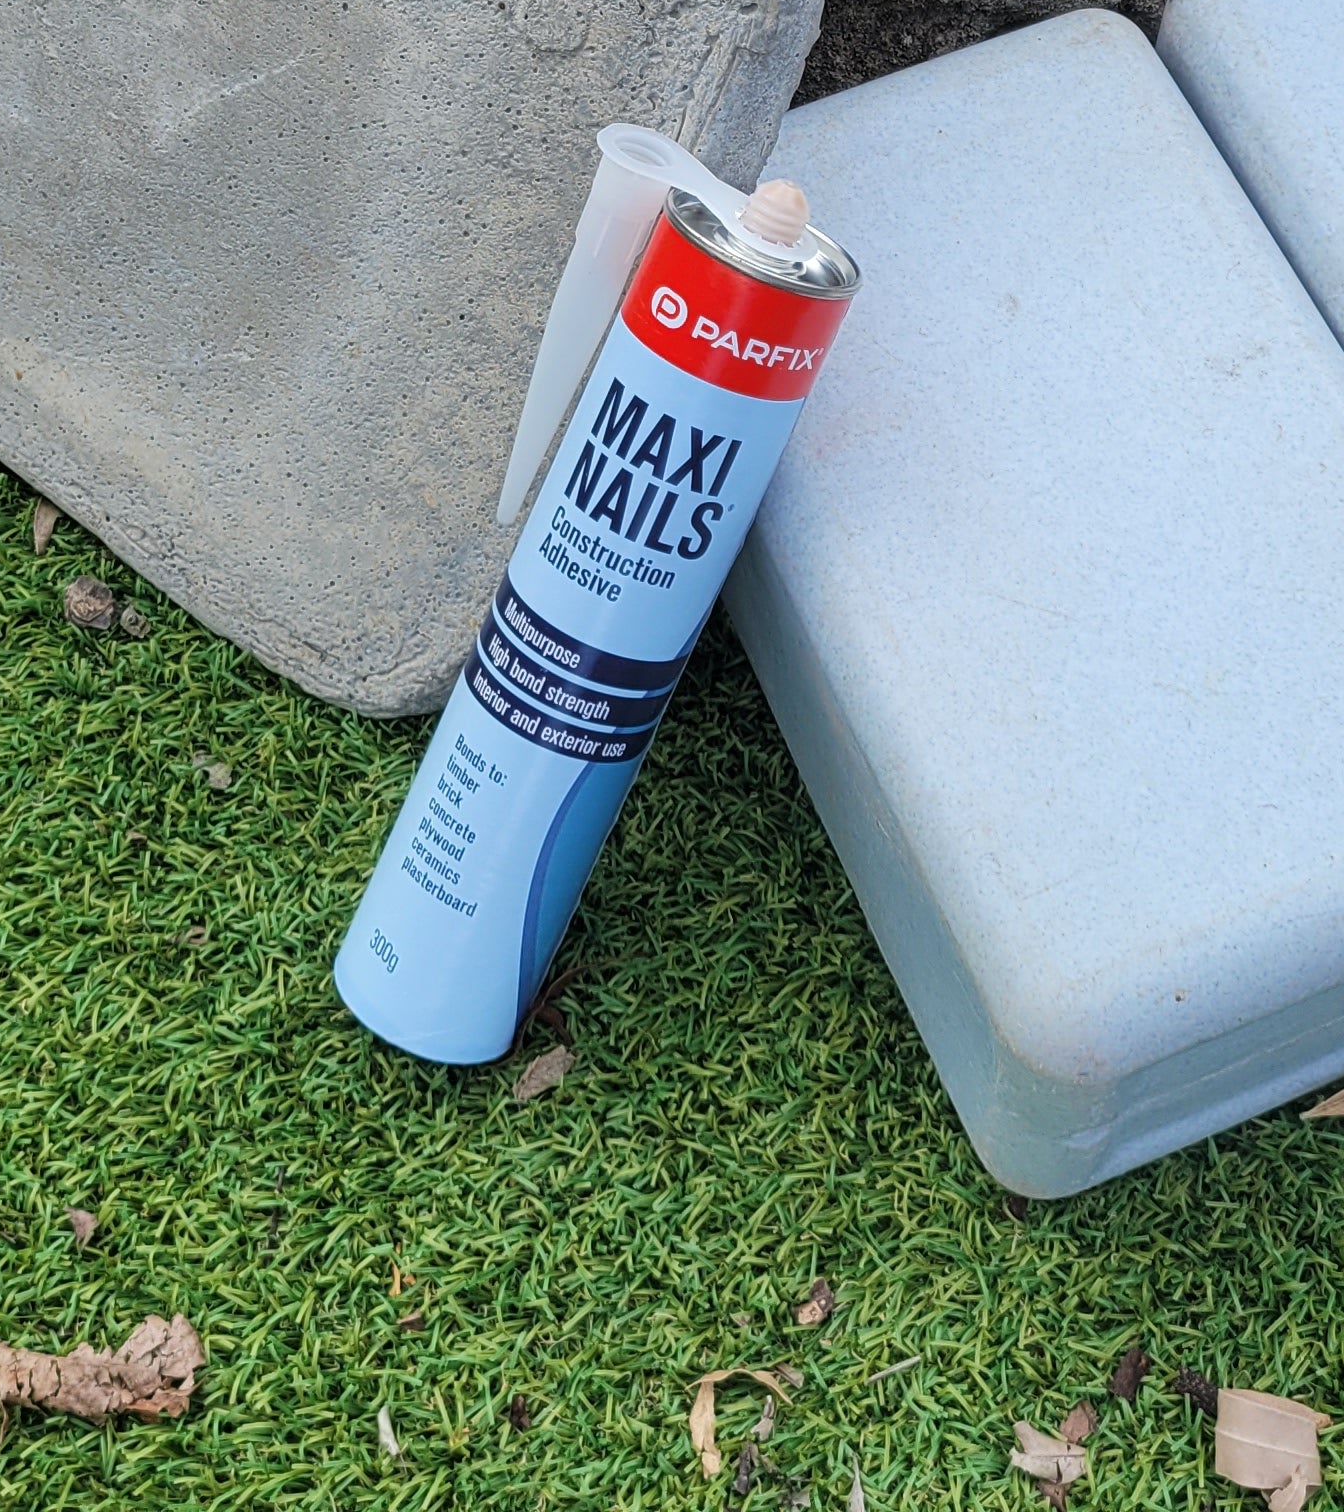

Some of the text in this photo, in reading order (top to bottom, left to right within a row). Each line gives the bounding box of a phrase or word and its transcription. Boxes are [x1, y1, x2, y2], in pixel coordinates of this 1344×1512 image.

[590, 377, 743, 497] MAXI
[539, 535, 623, 604] Adhesive
[551, 505, 676, 590] Construction
[504, 597, 581, 669] Multipurpose
[488, 634, 610, 722] High bond strength
[473, 669, 627, 758] Interior and exterior use
[447, 754, 481, 795] timber
[455, 733, 508, 787] Bonds to:
[428, 797, 477, 844] concrete
[437, 775, 464, 810] brick
[411, 835, 461, 886] ceramics
[419, 815, 466, 863] plywood
[401, 854, 478, 918] plasterboard
[369, 928, 399, 973] 300g
